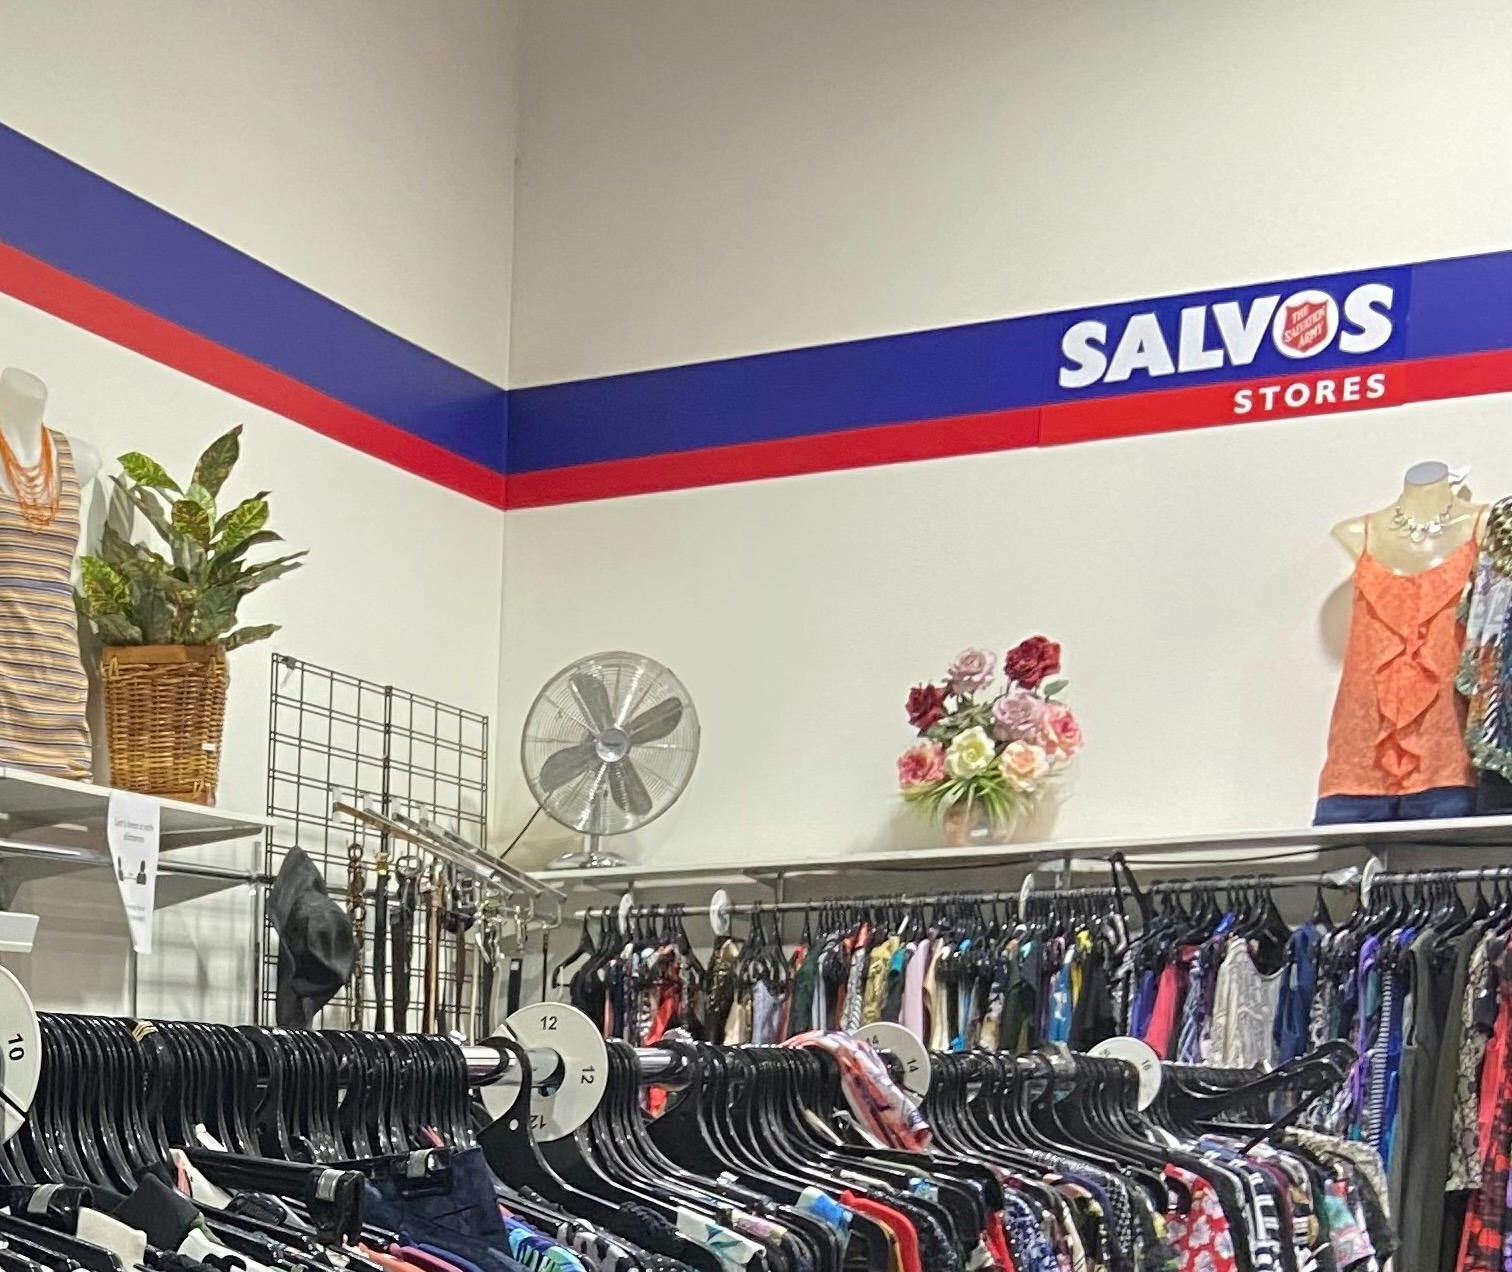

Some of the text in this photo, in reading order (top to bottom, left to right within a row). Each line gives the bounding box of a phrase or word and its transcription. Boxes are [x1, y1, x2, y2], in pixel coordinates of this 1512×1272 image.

[1059, 283, 1394, 388] SALVOS
[1233, 373, 1386, 414] STORES
[540, 1016, 558, 1031] 12
[8, 1033, 25, 1061] 10
[580, 1065, 595, 1085] 12
[907, 1059, 921, 1074] 14
[529, 1115, 547, 1130] 12
